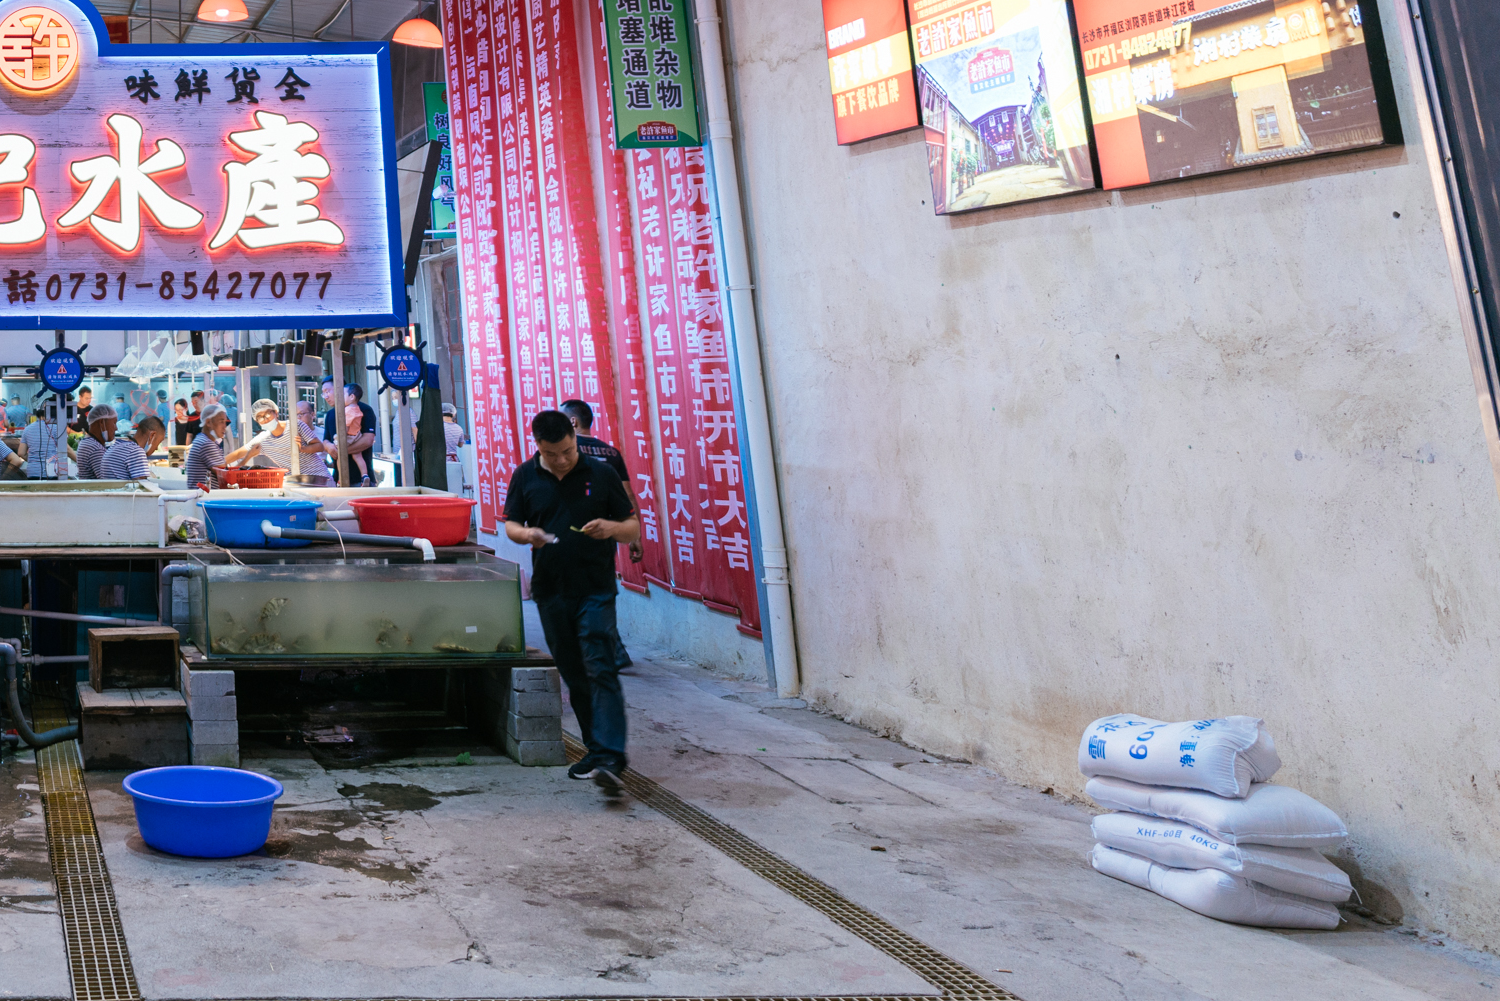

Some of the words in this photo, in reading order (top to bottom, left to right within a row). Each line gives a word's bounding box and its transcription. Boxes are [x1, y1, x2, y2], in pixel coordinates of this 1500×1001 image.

[827, 18, 866, 50] BRAND
[1081, 0, 1196, 44] 长沙市开福区浏阳河街道珠江花城
[124, 67, 312, 104] 味鮮貨全
[836, 78, 900, 118] 旗下餐饮品牌
[1189, 833, 1219, 851] 40KG
